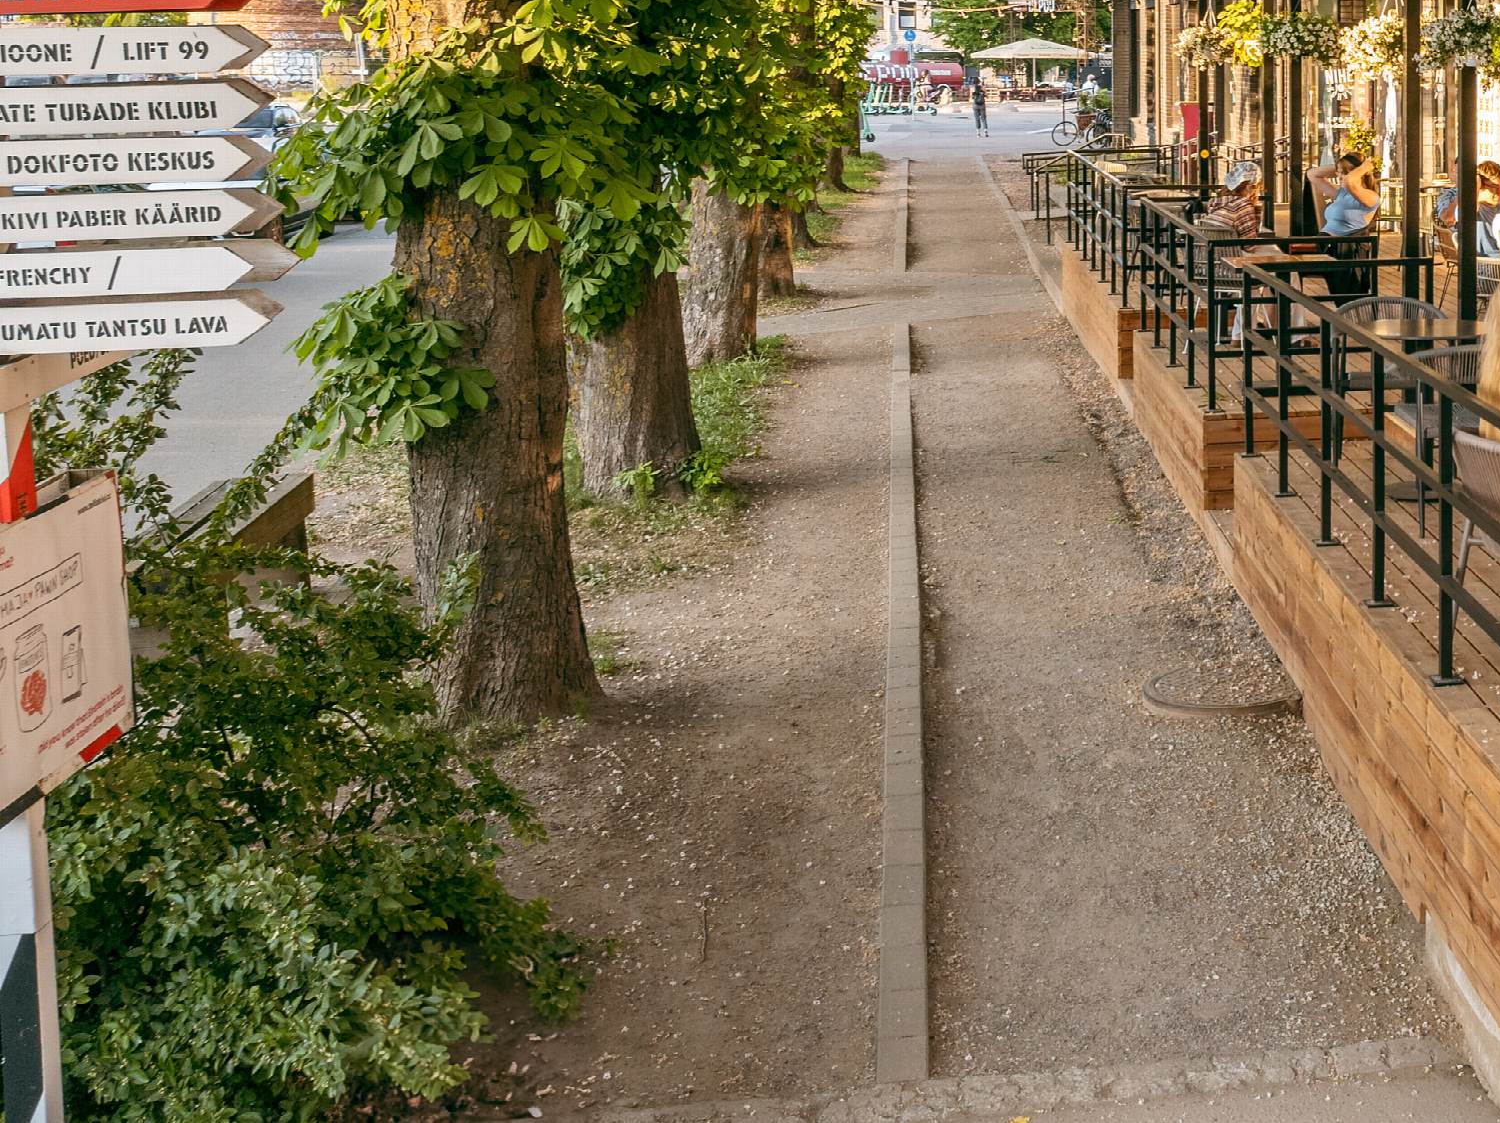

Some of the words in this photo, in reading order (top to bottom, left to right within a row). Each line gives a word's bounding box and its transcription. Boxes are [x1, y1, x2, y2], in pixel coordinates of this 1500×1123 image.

[91, 35, 104, 69] /
[123, 42, 168, 61] LIFT
[178, 41, 209, 60] 99
[45, 102, 140, 122] TUBADE
[148, 100, 218, 121] KLUBI
[7, 153, 119, 174] DOKFOTO
[128, 150, 215, 172] KESKUS
[2, 212, 48, 230] KIVI
[56, 209, 127, 228] PABER
[135, 202, 222, 225] KÄÄRID
[107, 255, 122, 290] /
[85, 318, 166, 337] TANTSU
[175, 315, 229, 334] LAVA
